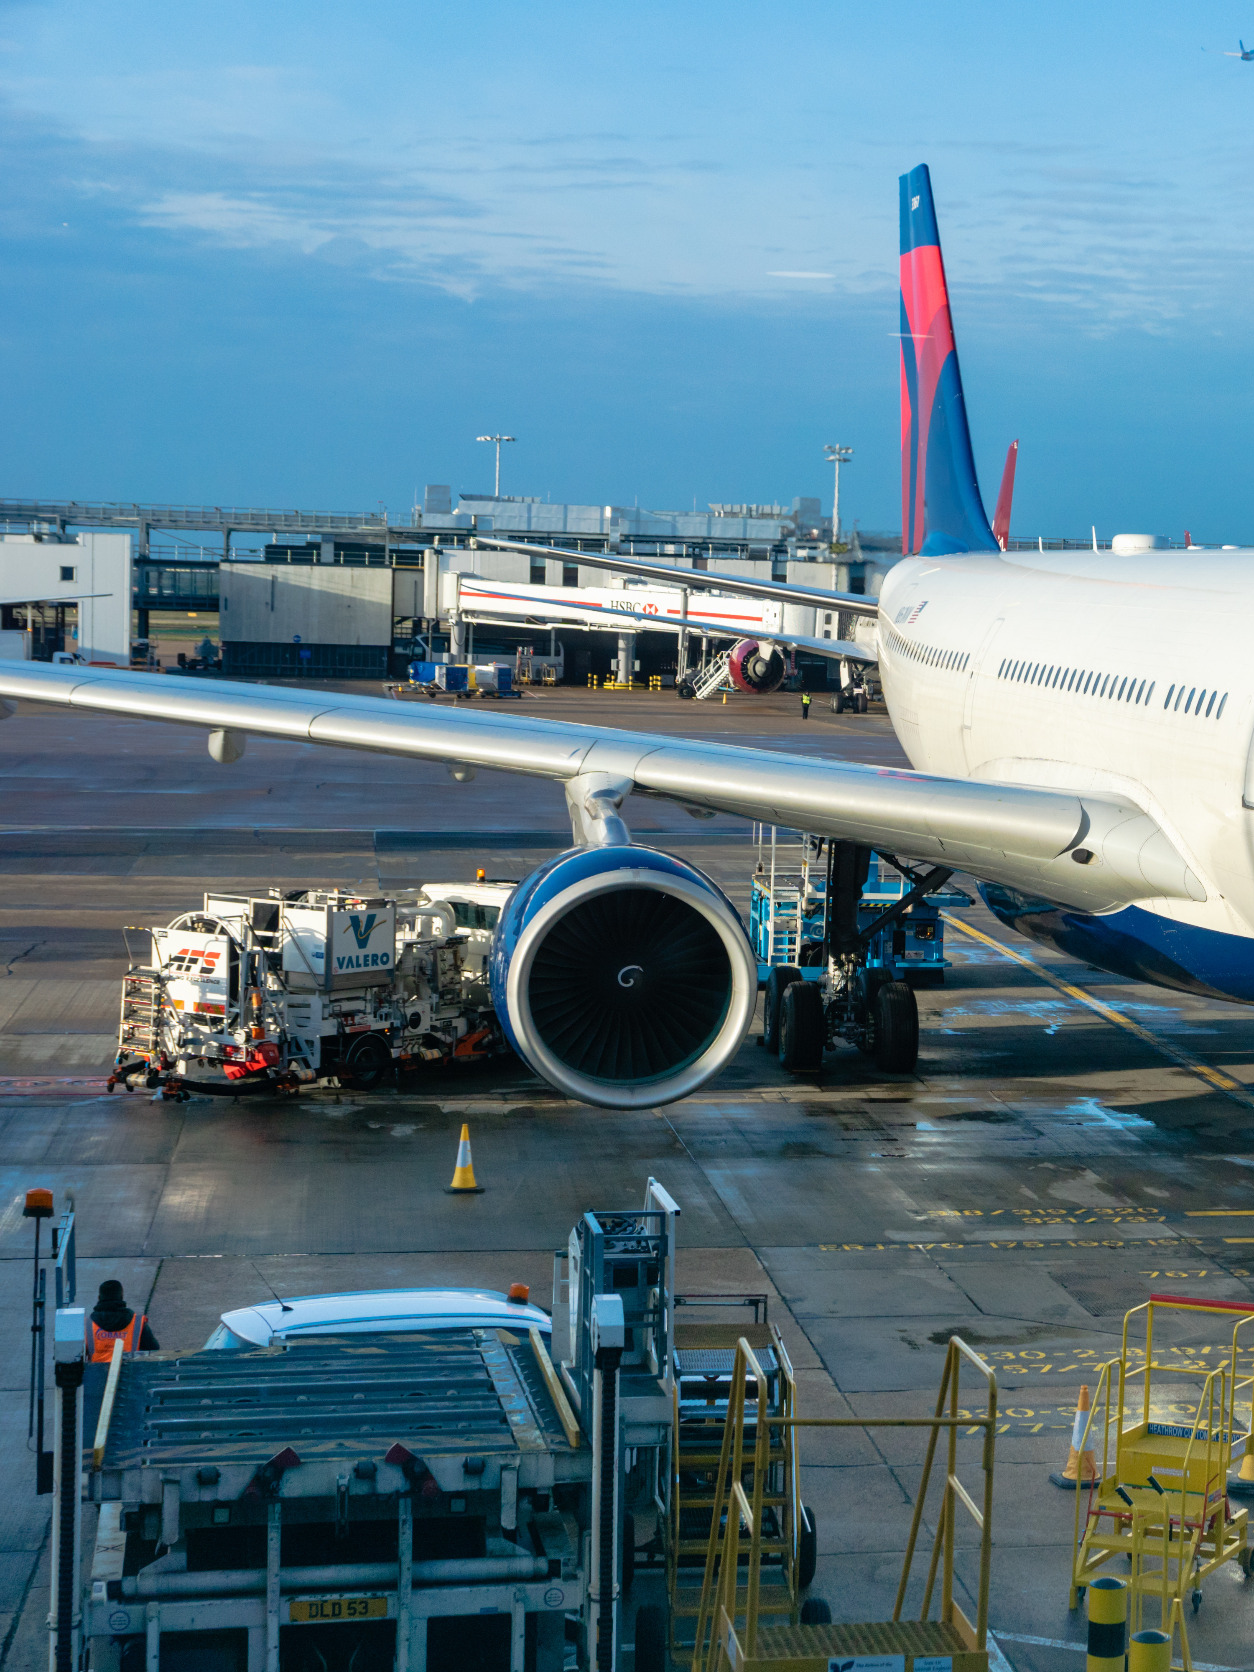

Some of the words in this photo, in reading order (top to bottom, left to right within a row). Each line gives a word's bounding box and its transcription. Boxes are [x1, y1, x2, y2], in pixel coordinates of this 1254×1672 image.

[336, 952, 390, 970] VALERO
[1149, 1423, 1183, 1438] HEATHROW
[308, 1601, 342, 1619] DLD
[347, 1600, 369, 1616] 53
